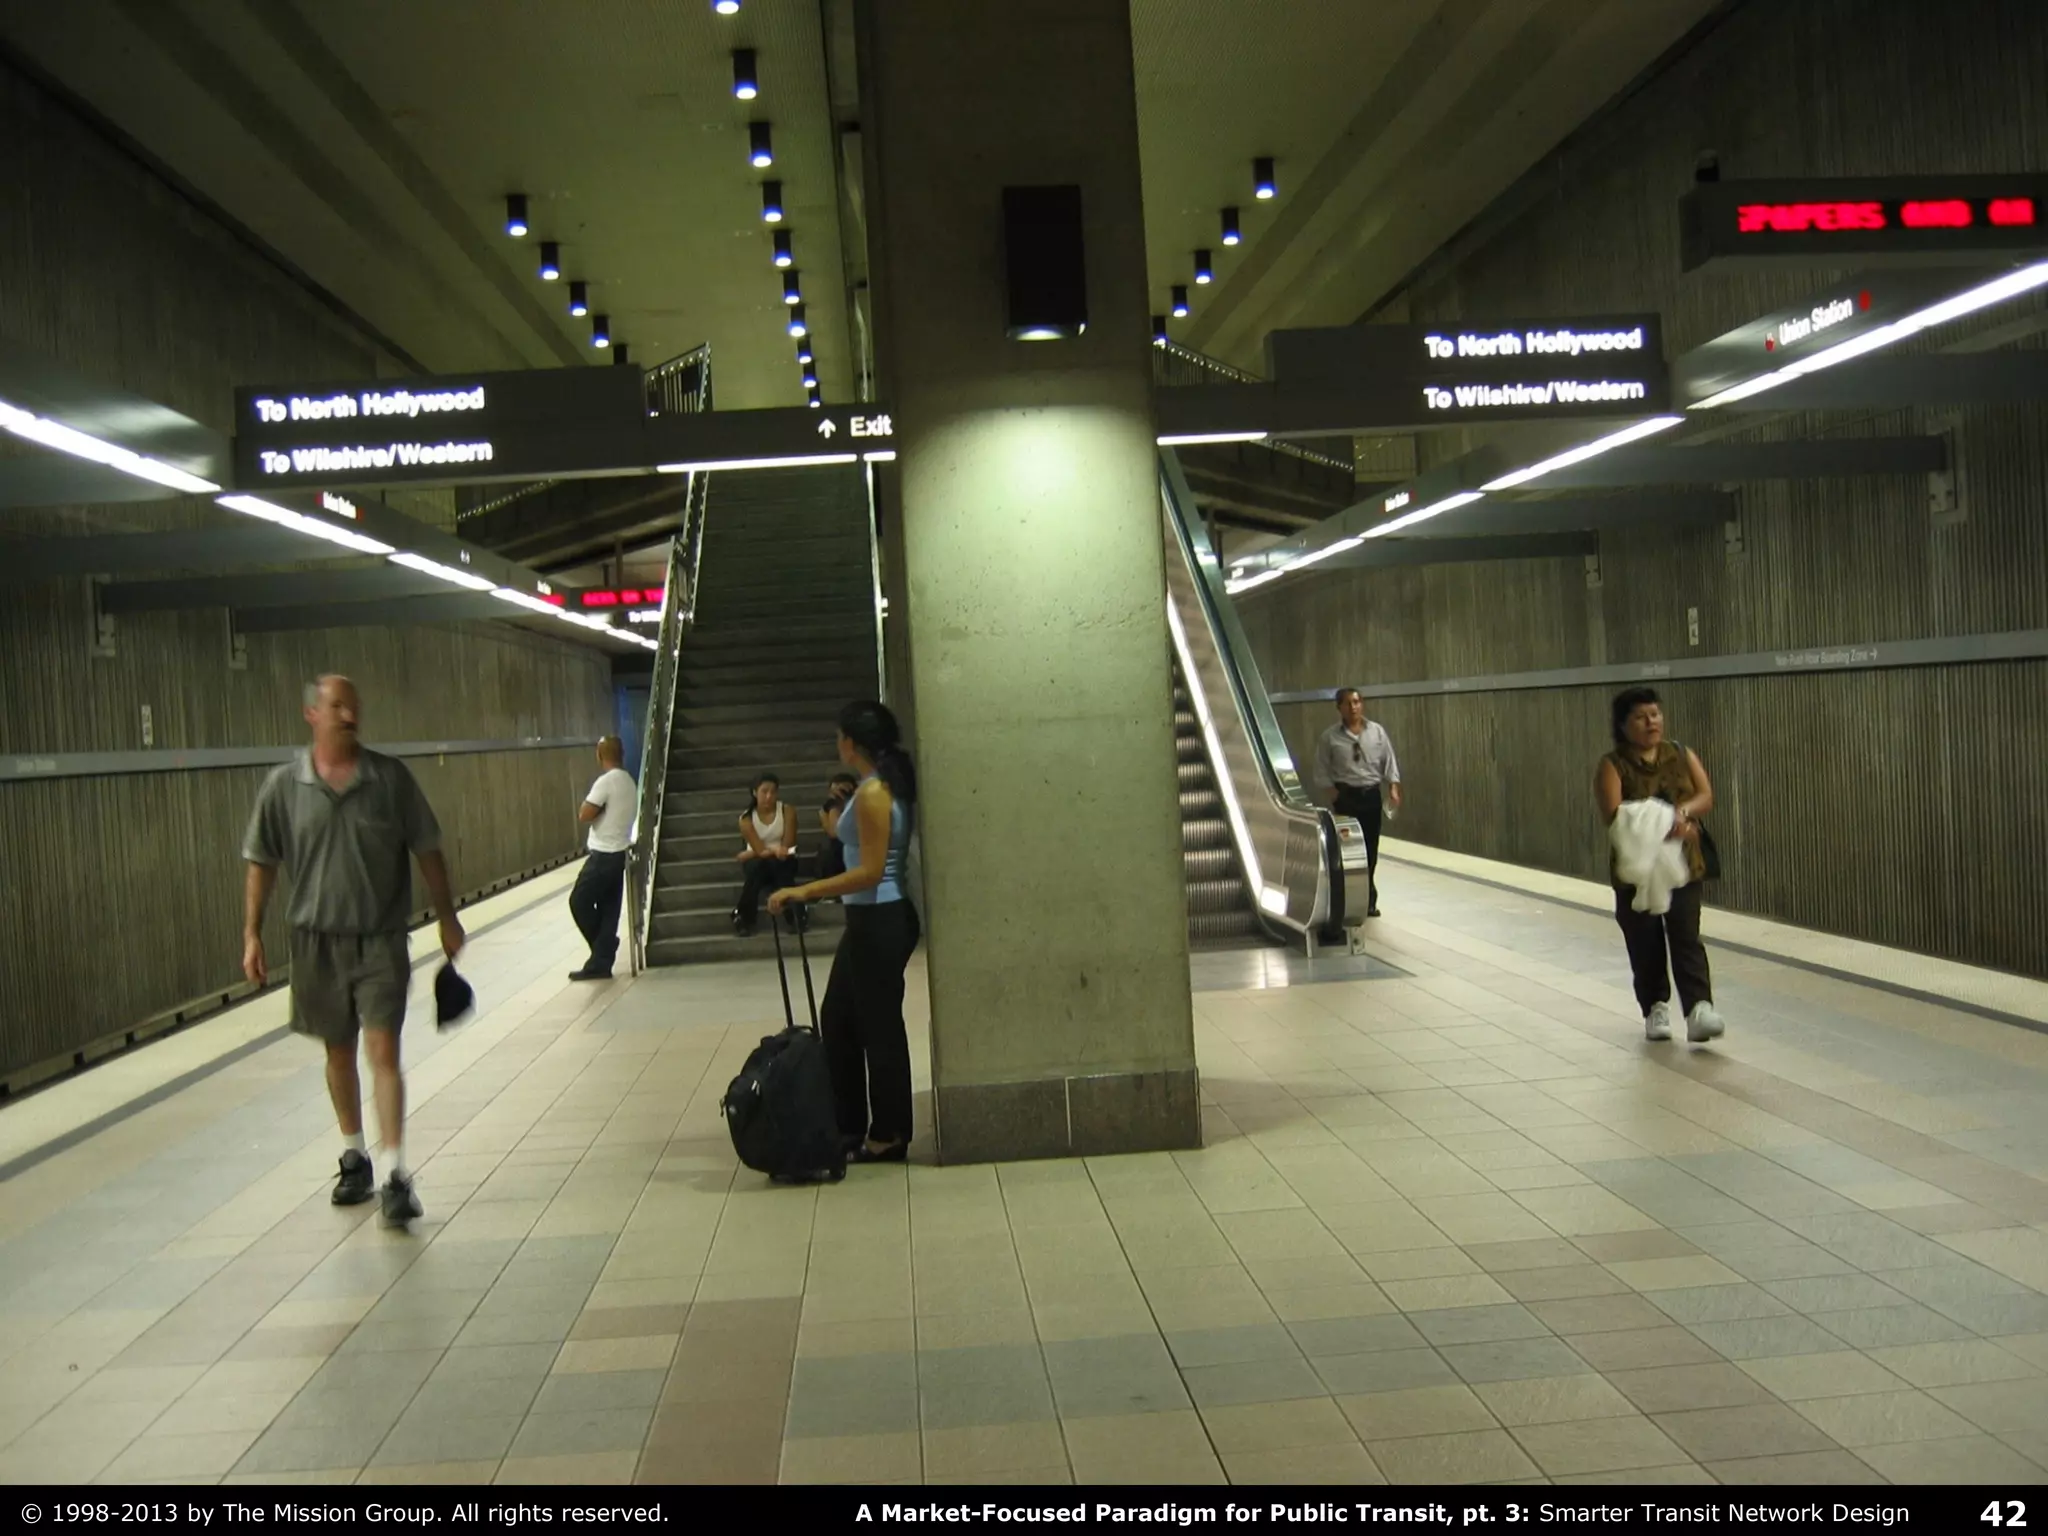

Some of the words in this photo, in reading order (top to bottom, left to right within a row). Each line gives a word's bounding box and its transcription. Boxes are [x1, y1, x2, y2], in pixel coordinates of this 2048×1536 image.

[1779, 317, 1811, 346] Union
[1811, 298, 1852, 332] Station
[1424, 336, 1453, 358] To
[1458, 332, 1521, 356] North
[1526, 328, 1642, 356] Hollywood
[256, 399, 287, 422] To
[291, 394, 357, 420] North
[362, 386, 485, 417] Hollywood
[1423, 387, 1452, 409] To
[1454, 380, 1644, 407] Wilshire/Western
[850, 414, 893, 437] Exit
[261, 451, 291, 474] To
[292, 441, 493, 472] Wilshire/Western
